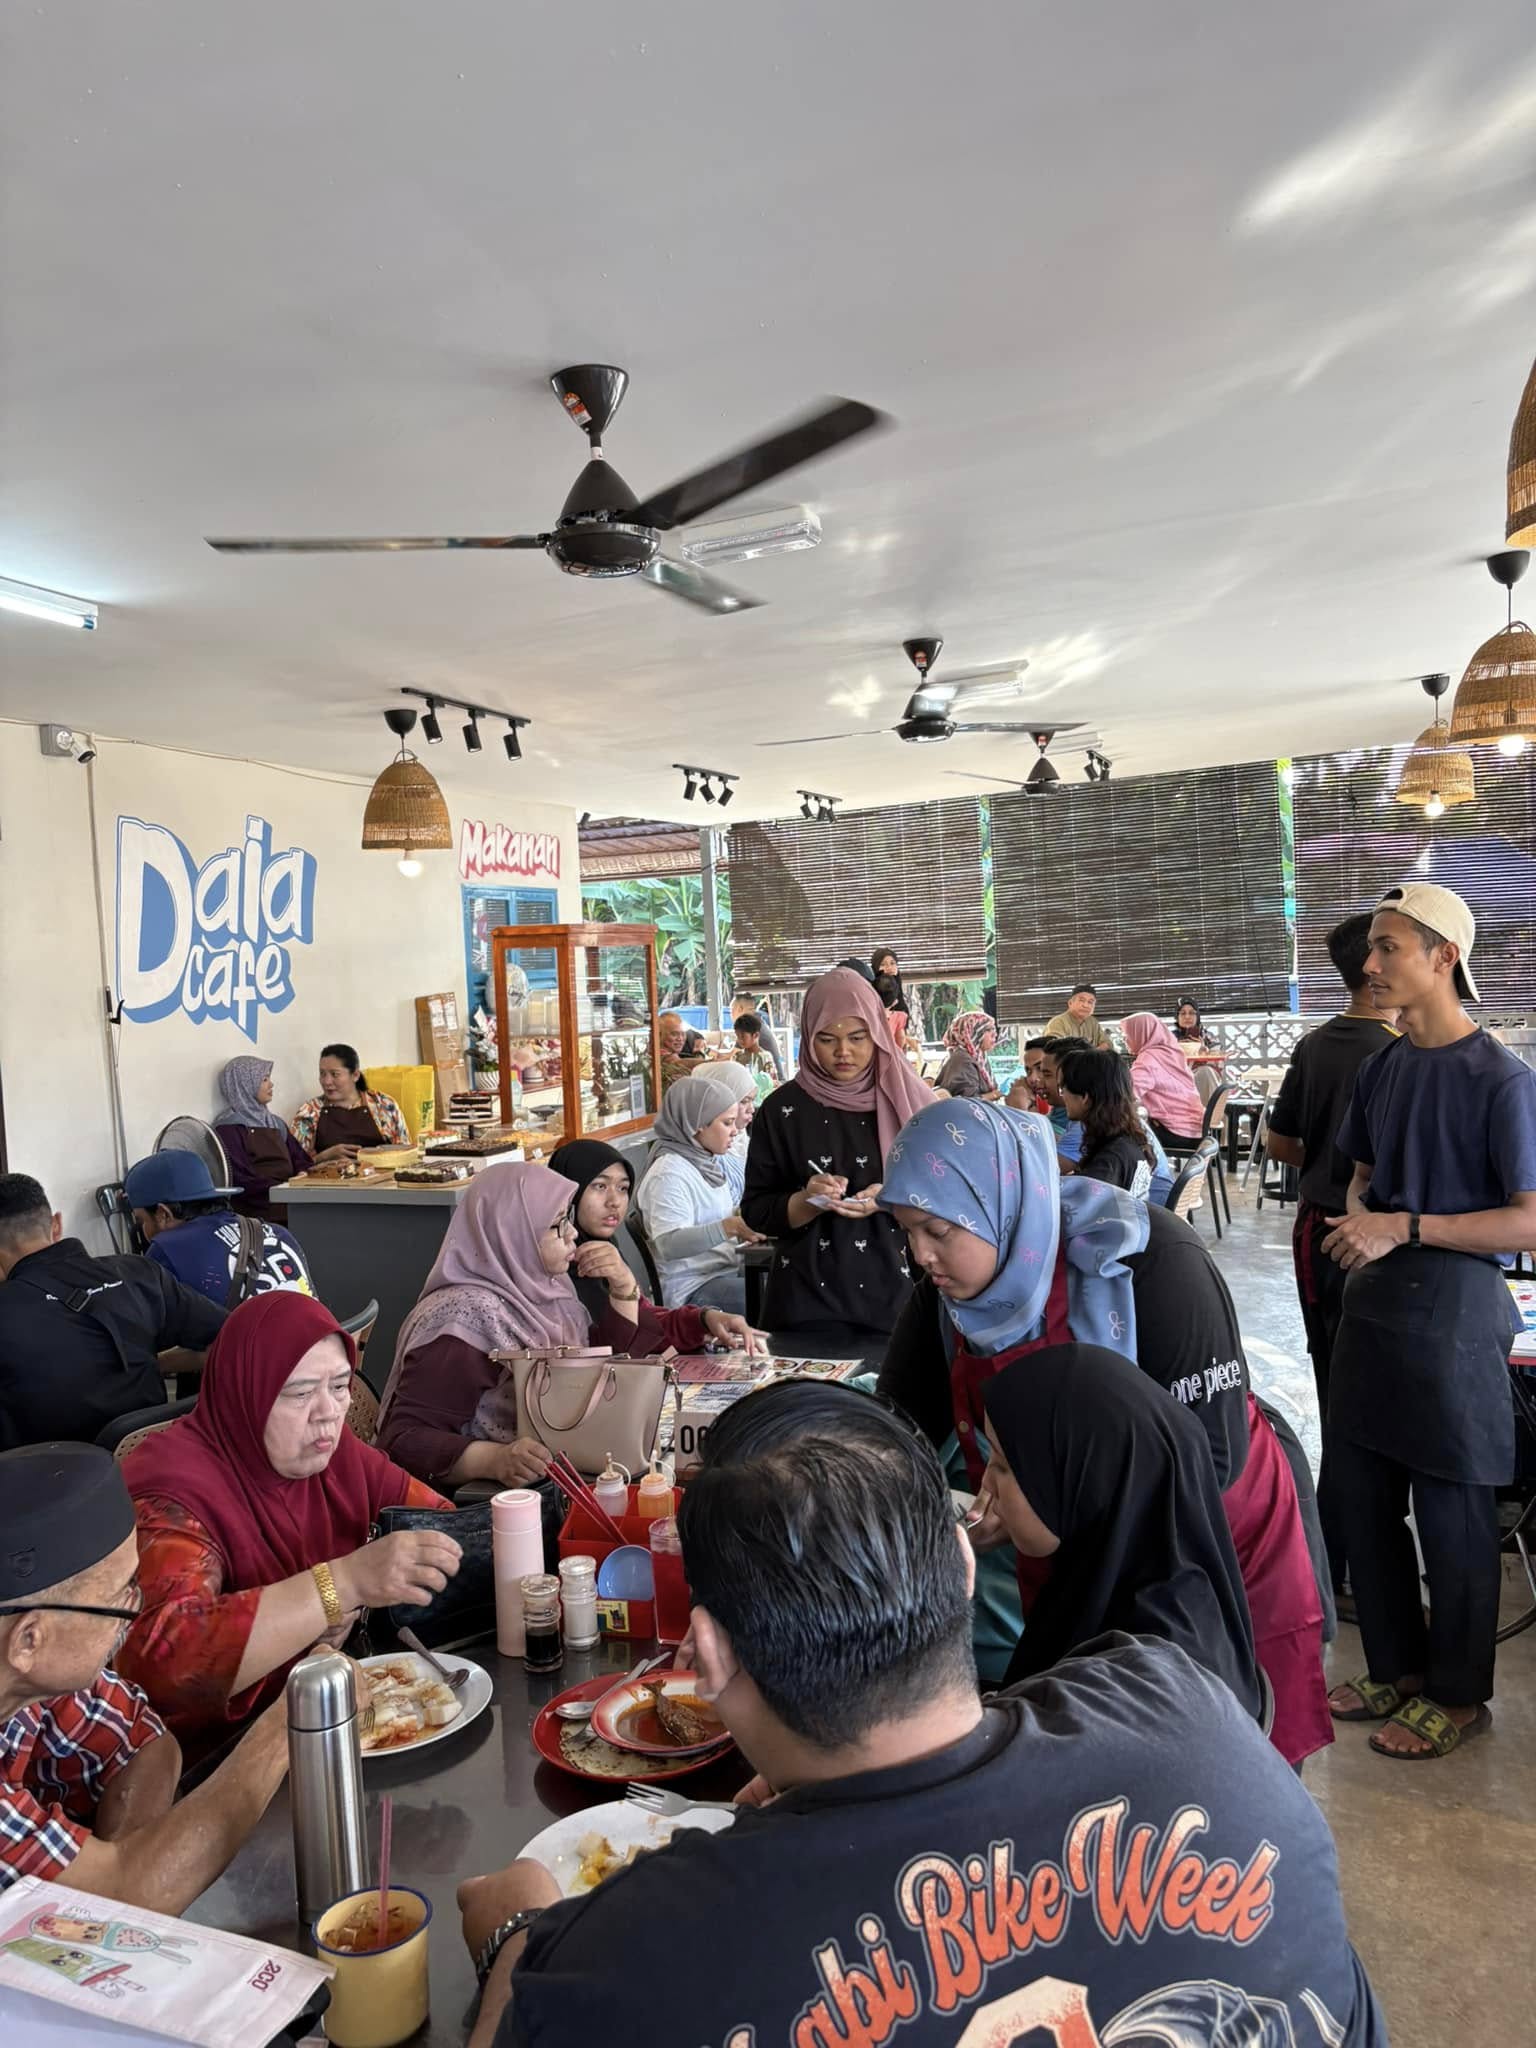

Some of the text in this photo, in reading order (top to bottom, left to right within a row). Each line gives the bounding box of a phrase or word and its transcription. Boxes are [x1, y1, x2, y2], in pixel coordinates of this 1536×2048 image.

[459, 819, 560, 879] Makanan
[1171, 1357, 1241, 1403] one piece
[898, 1840, 1068, 2012] Bike
[1065, 1796, 1280, 1946] Week
